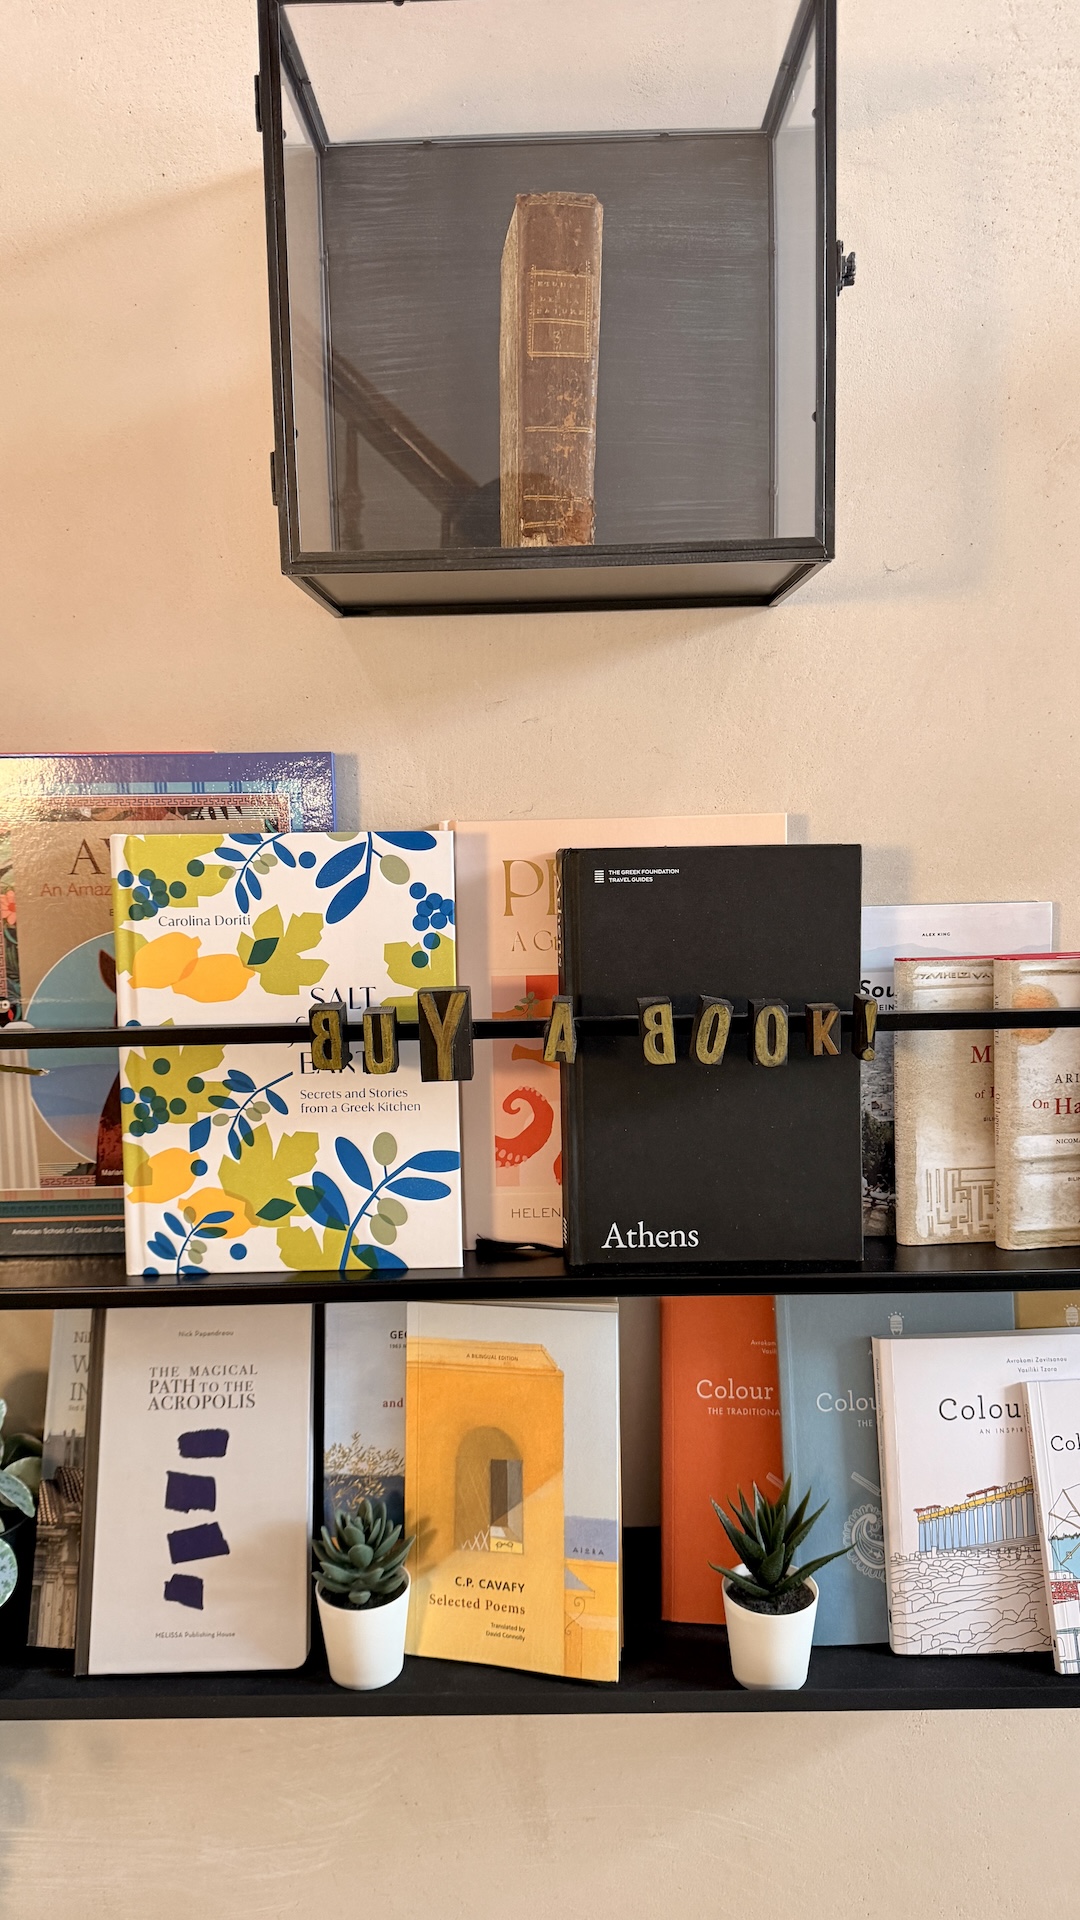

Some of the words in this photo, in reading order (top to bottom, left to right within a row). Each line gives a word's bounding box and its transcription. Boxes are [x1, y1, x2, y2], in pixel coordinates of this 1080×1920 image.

[40, 883, 61, 897] An
[158, 915, 211, 927] Carolina
[214, 914, 251, 926] Doriti
[511, 932, 527, 951] A
[544, 1002, 575, 1063] A
[300, 1089, 342, 1100] Secrets
[345, 1088, 366, 1099] and
[369, 1087, 408, 1098] Stories
[975, 1089, 985, 1098] of
[300, 1102, 329, 1114] from
[331, 1105, 337, 1113] a
[341, 1102, 375, 1112] Greek
[377, 1101, 421, 1112] Kitchen
[1033, 1099, 1049, 1109] On
[511, 1207, 561, 1219] HELEN
[11, 1228, 42, 1236] American
[43, 1227, 65, 1235] School
[601, 1220, 699, 1249] Athens
[149, 1366, 180, 1378] THE
[189, 1364, 258, 1377] MAGICAL
[149, 1378, 196, 1394] PATH
[199, 1381, 219, 1393] TO
[223, 1380, 254, 1392] THE
[696, 1378, 774, 1400] Colour
[148, 1393, 256, 1411] ACROPOLIS
[383, 1398, 403, 1408] and
[939, 1394, 1021, 1421] Colou
[708, 1407, 723, 1415] THE
[857, 1419, 873, 1427] THE
[455, 1576, 474, 1588] C.P.
[479, 1579, 525, 1593] CAVAFY
[429, 1593, 480, 1609] Selected
[485, 1600, 526, 1615] Poems
[491, 1622, 517, 1632] Translated
[184, 1631, 215, 1639] Publishing
[486, 1630, 501, 1638] David
[502, 1632, 525, 1642] Connolly
